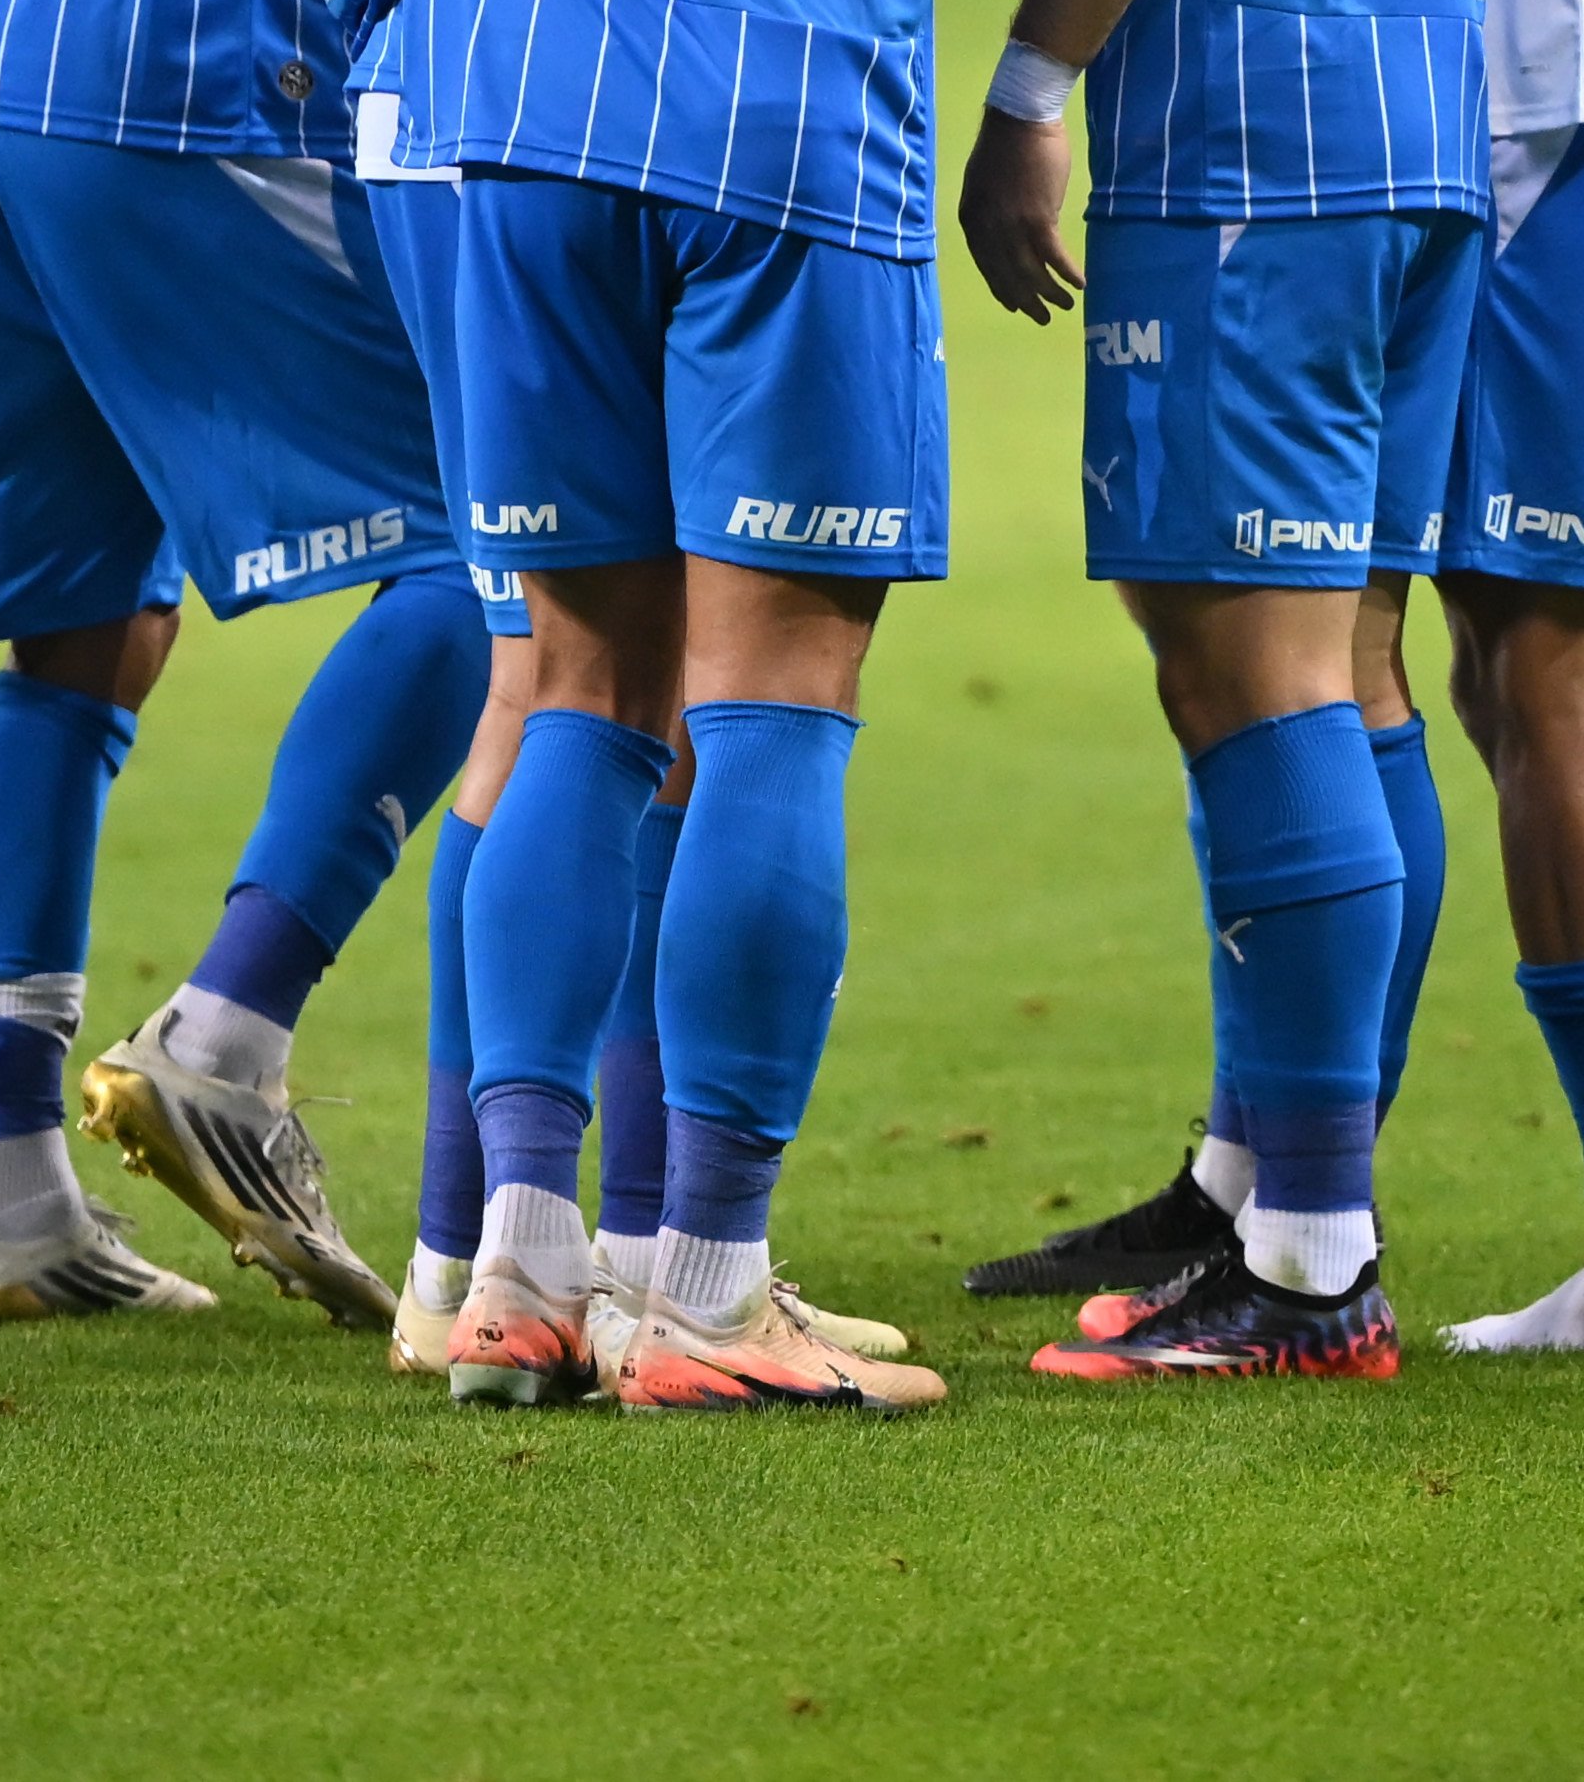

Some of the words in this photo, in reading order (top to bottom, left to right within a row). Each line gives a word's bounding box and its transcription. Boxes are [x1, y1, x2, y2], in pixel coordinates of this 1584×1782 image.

[725, 496, 907, 548] RURIS
[1269, 519, 1373, 553] PINU
[235, 506, 405, 596] RURIS
